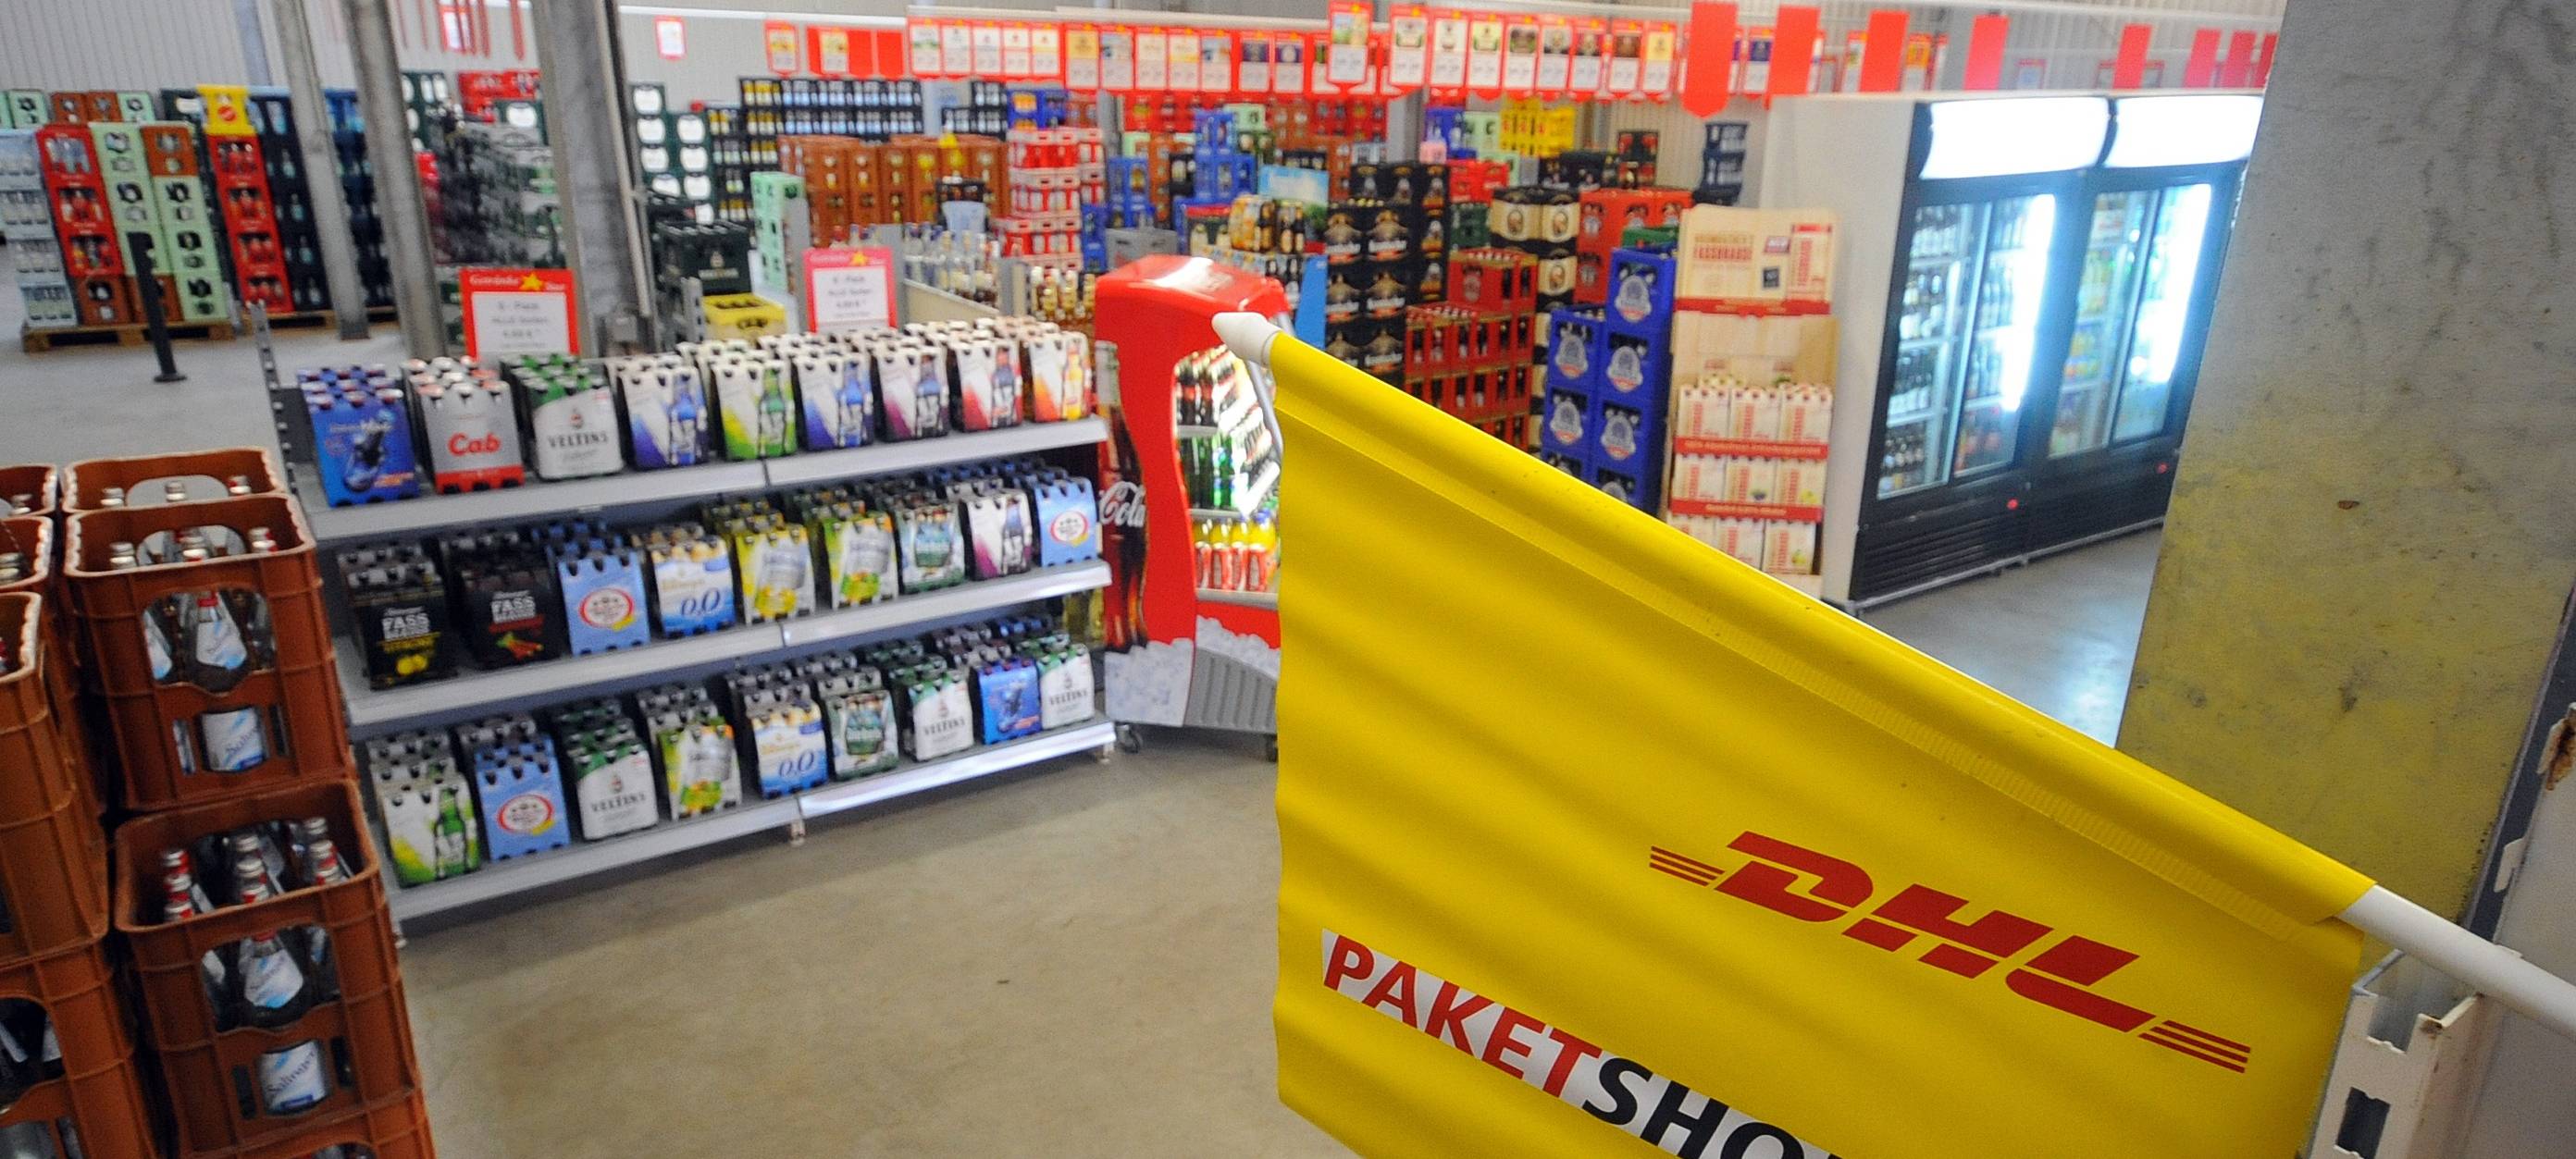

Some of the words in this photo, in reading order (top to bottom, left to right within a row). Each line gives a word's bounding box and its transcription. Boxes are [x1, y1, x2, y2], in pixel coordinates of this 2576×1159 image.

[448, 432, 502, 456] Cab
[548, 432, 609, 448] VELTINS
[1713, 832, 2155, 1033] DHL
[1324, 934, 1843, 1159] PAKETSHO
